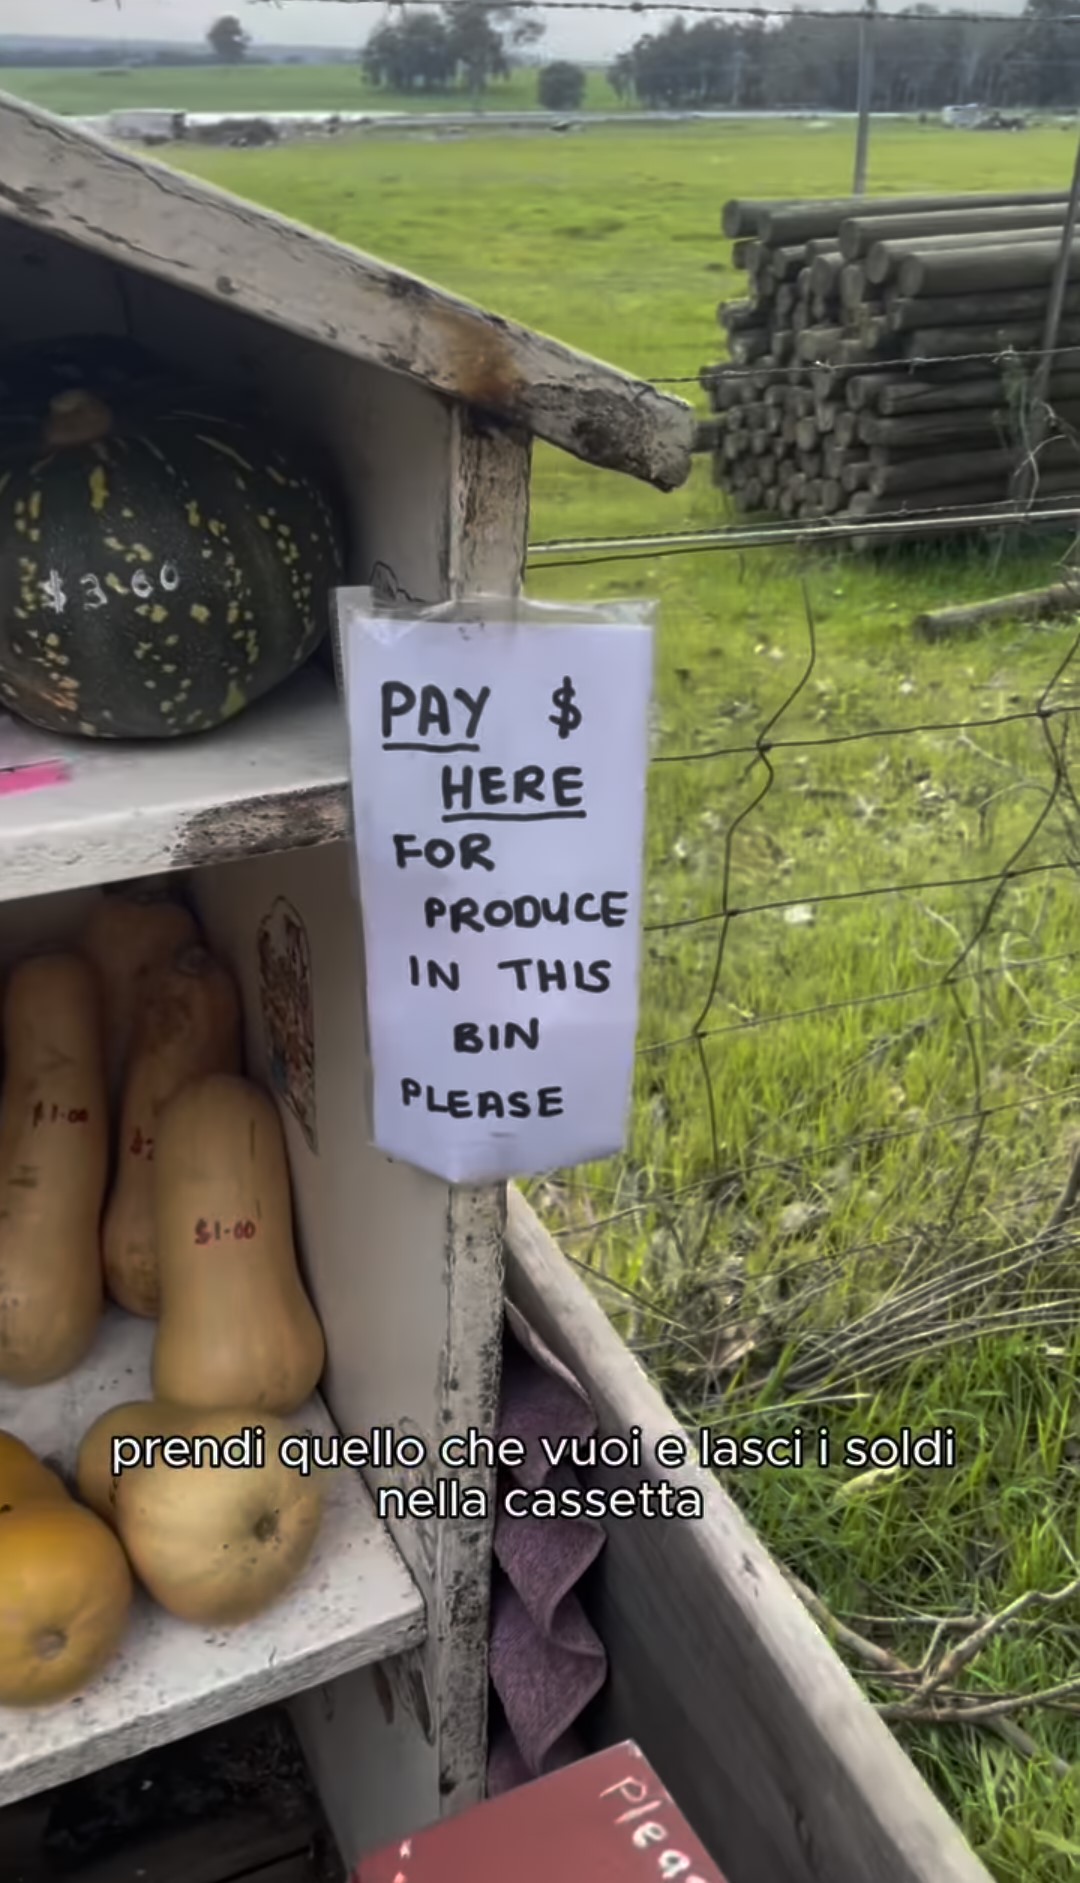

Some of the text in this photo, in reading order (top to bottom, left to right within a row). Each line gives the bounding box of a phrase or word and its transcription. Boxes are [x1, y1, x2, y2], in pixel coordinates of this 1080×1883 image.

[380, 675, 582, 739] PAY $
[441, 764, 584, 810] HERE
[392, 832, 496, 872] FOR
[424, 890, 628, 933] PRODUCE
[409, 955, 611, 993] IN THIS
[453, 1017, 539, 1054] BIN
[401, 1077, 564, 1119] PLEASE
[599, 1776, 707, 1883] Plea
